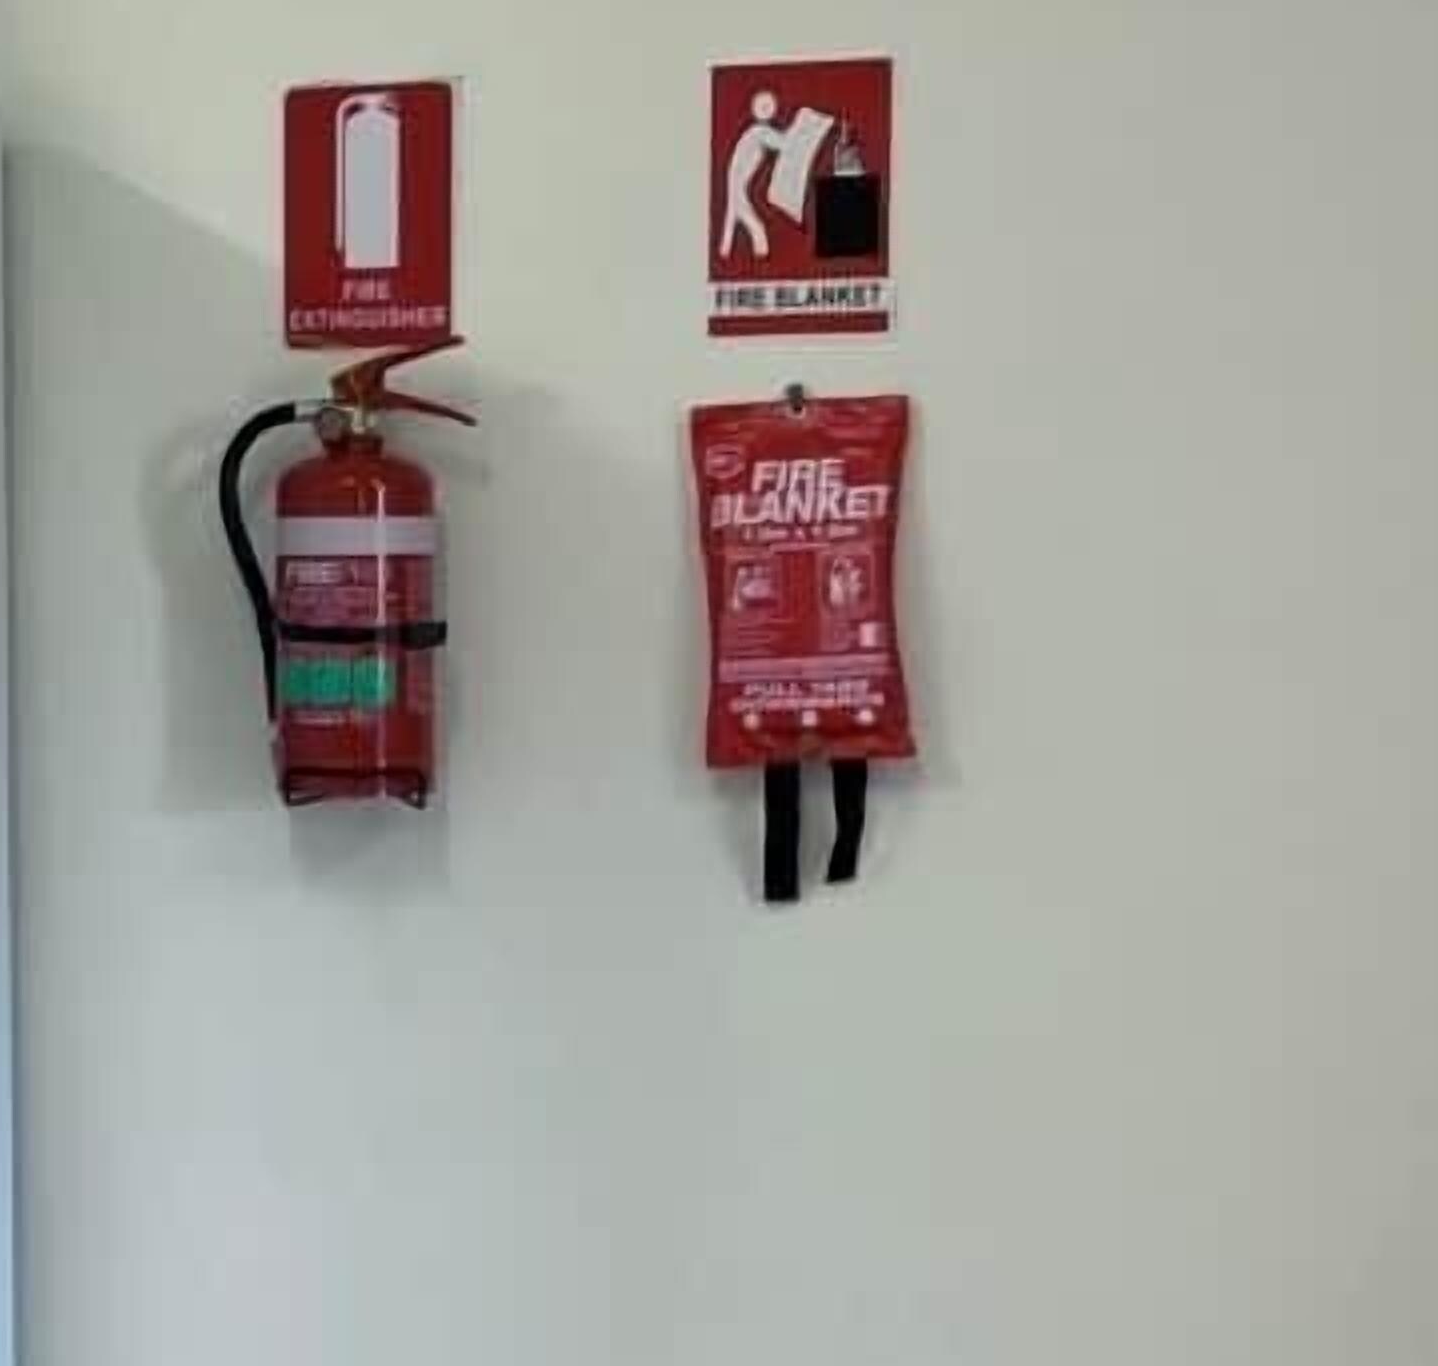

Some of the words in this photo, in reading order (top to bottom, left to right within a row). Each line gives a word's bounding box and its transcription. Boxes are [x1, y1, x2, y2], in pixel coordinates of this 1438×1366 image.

[341, 279, 391, 301] FIRE
[714, 286, 766, 309] FIRE
[774, 283, 882, 308] BLANKET
[289, 306, 447, 332] EXTINGUISHER
[752, 458, 846, 493] FIRE
[710, 485, 890, 528] BLANKET
